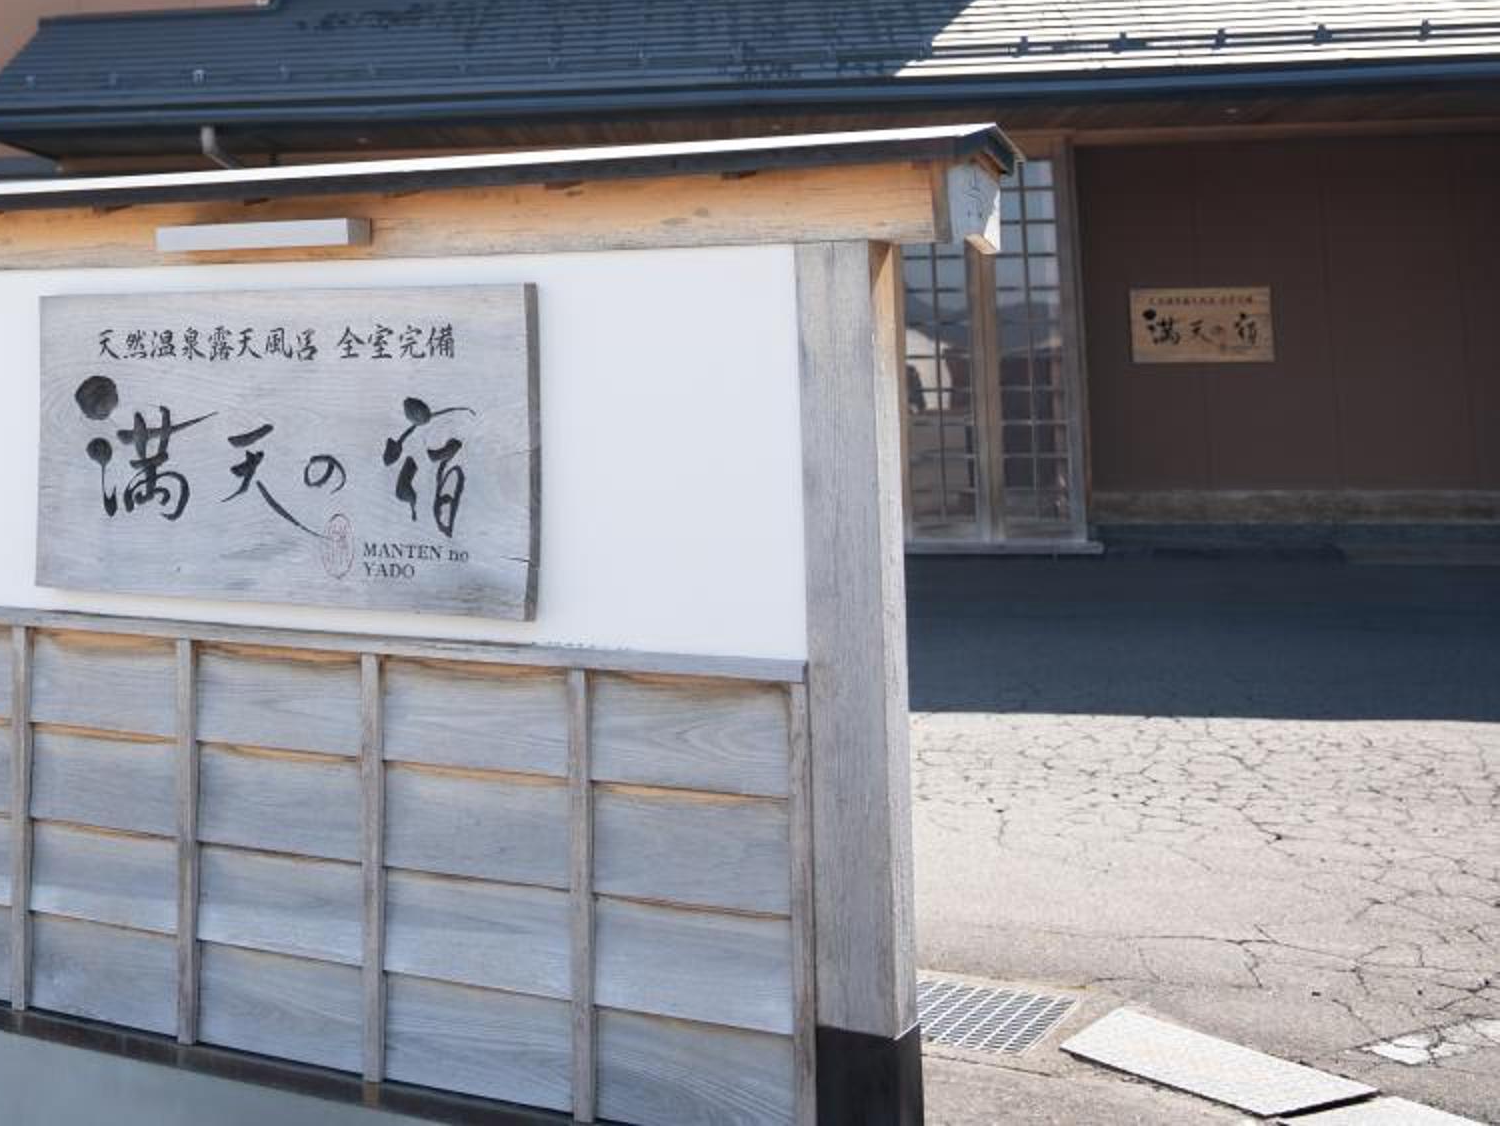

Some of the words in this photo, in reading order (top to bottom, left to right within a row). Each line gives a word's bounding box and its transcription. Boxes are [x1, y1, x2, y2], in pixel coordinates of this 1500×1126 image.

[98, 325, 318, 361] 天然温泉露天風呂
[336, 323, 455, 360] 全室完備
[75, 375, 477, 539] 満天の宿
[363, 542, 443, 562] MANTEN
[449, 549, 469, 563] no
[363, 561, 415, 579] YADO
